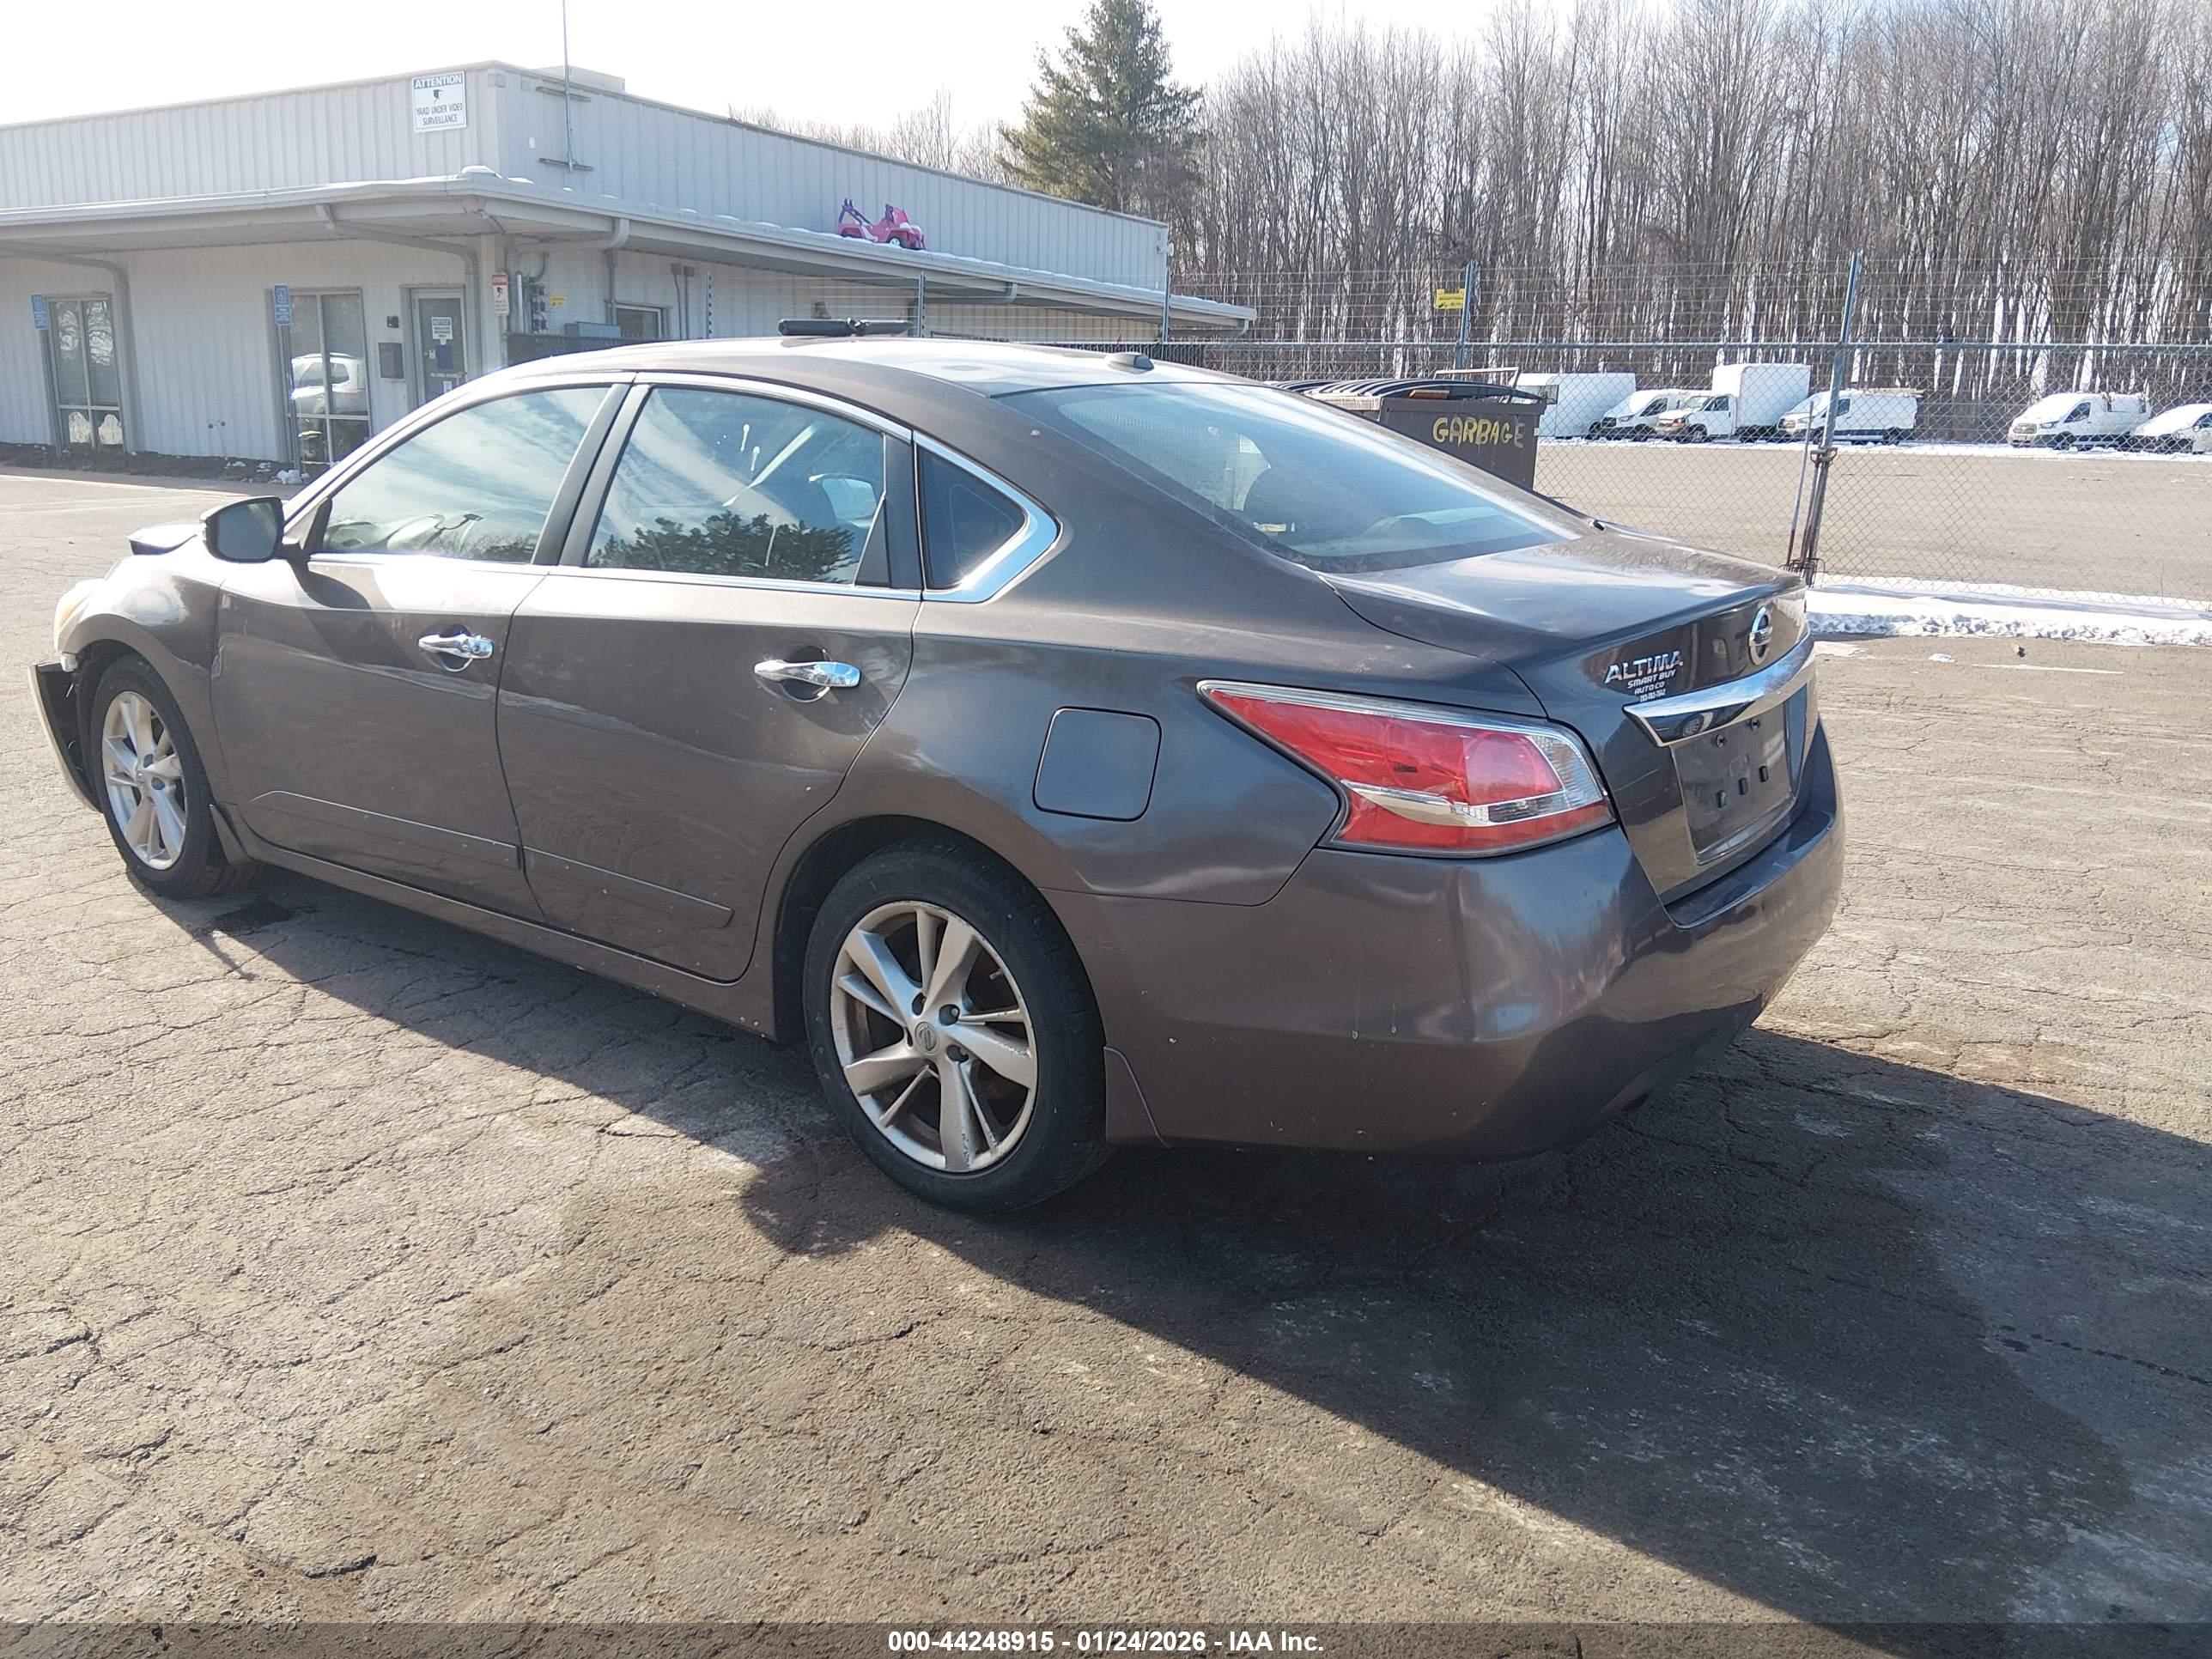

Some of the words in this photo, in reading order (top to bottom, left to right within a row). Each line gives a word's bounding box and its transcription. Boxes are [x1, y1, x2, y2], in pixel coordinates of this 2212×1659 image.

[415, 74, 462, 88] ATTENTION
[416, 106, 430, 116] YARD
[431, 104, 447, 114] UNDER
[448, 102, 463, 112] VIDEO
[422, 113, 459, 126] SURVEILLANCE
[1432, 416, 1525, 448] GARBAGE
[1604, 651, 1683, 684] ALTIMA
[1627, 674, 1658, 689] SMART
[1659, 669, 1676, 680] BUY
